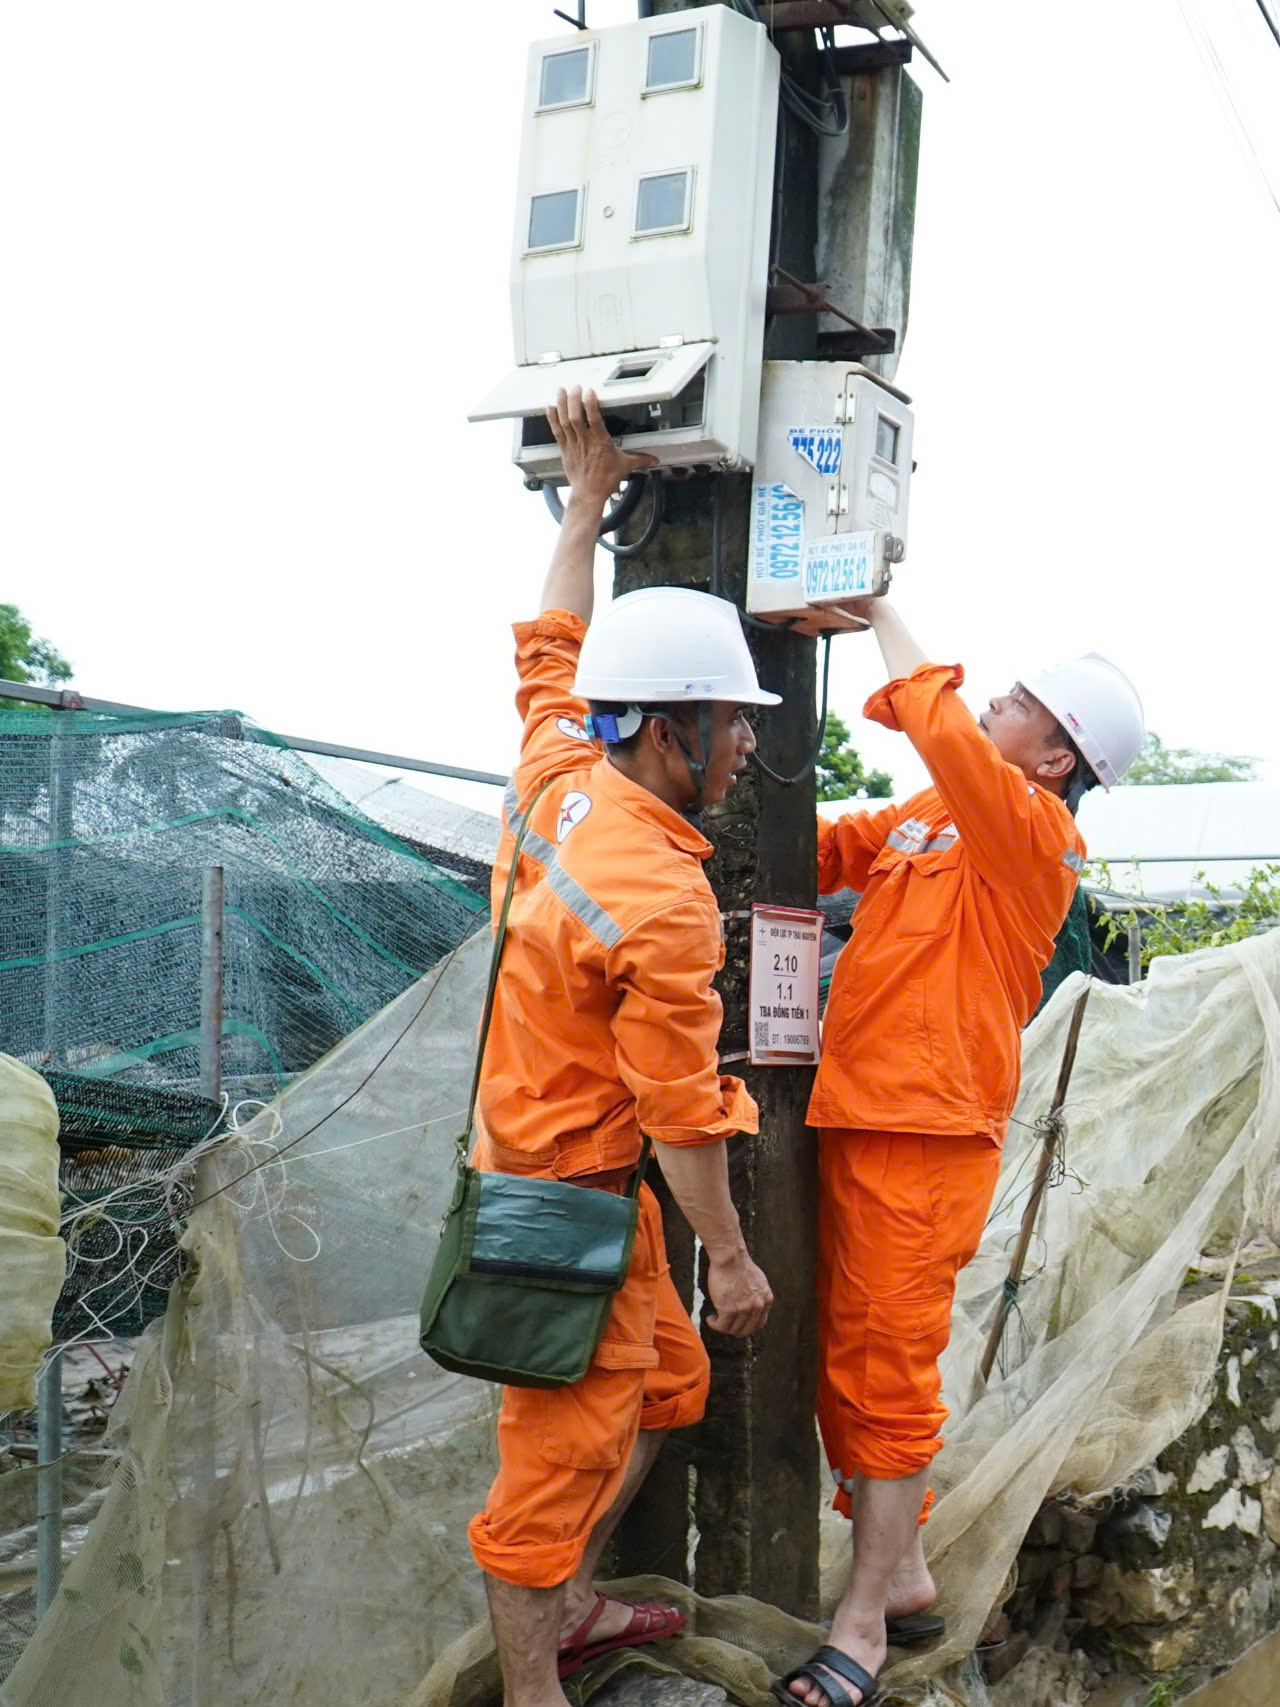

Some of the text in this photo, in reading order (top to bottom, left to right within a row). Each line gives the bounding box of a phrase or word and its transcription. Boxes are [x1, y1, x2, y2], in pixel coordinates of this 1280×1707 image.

[773, 953, 798, 973] 2.10
[777, 982, 793, 1000] 1.1
[759, 1005, 772, 1017] TBA
